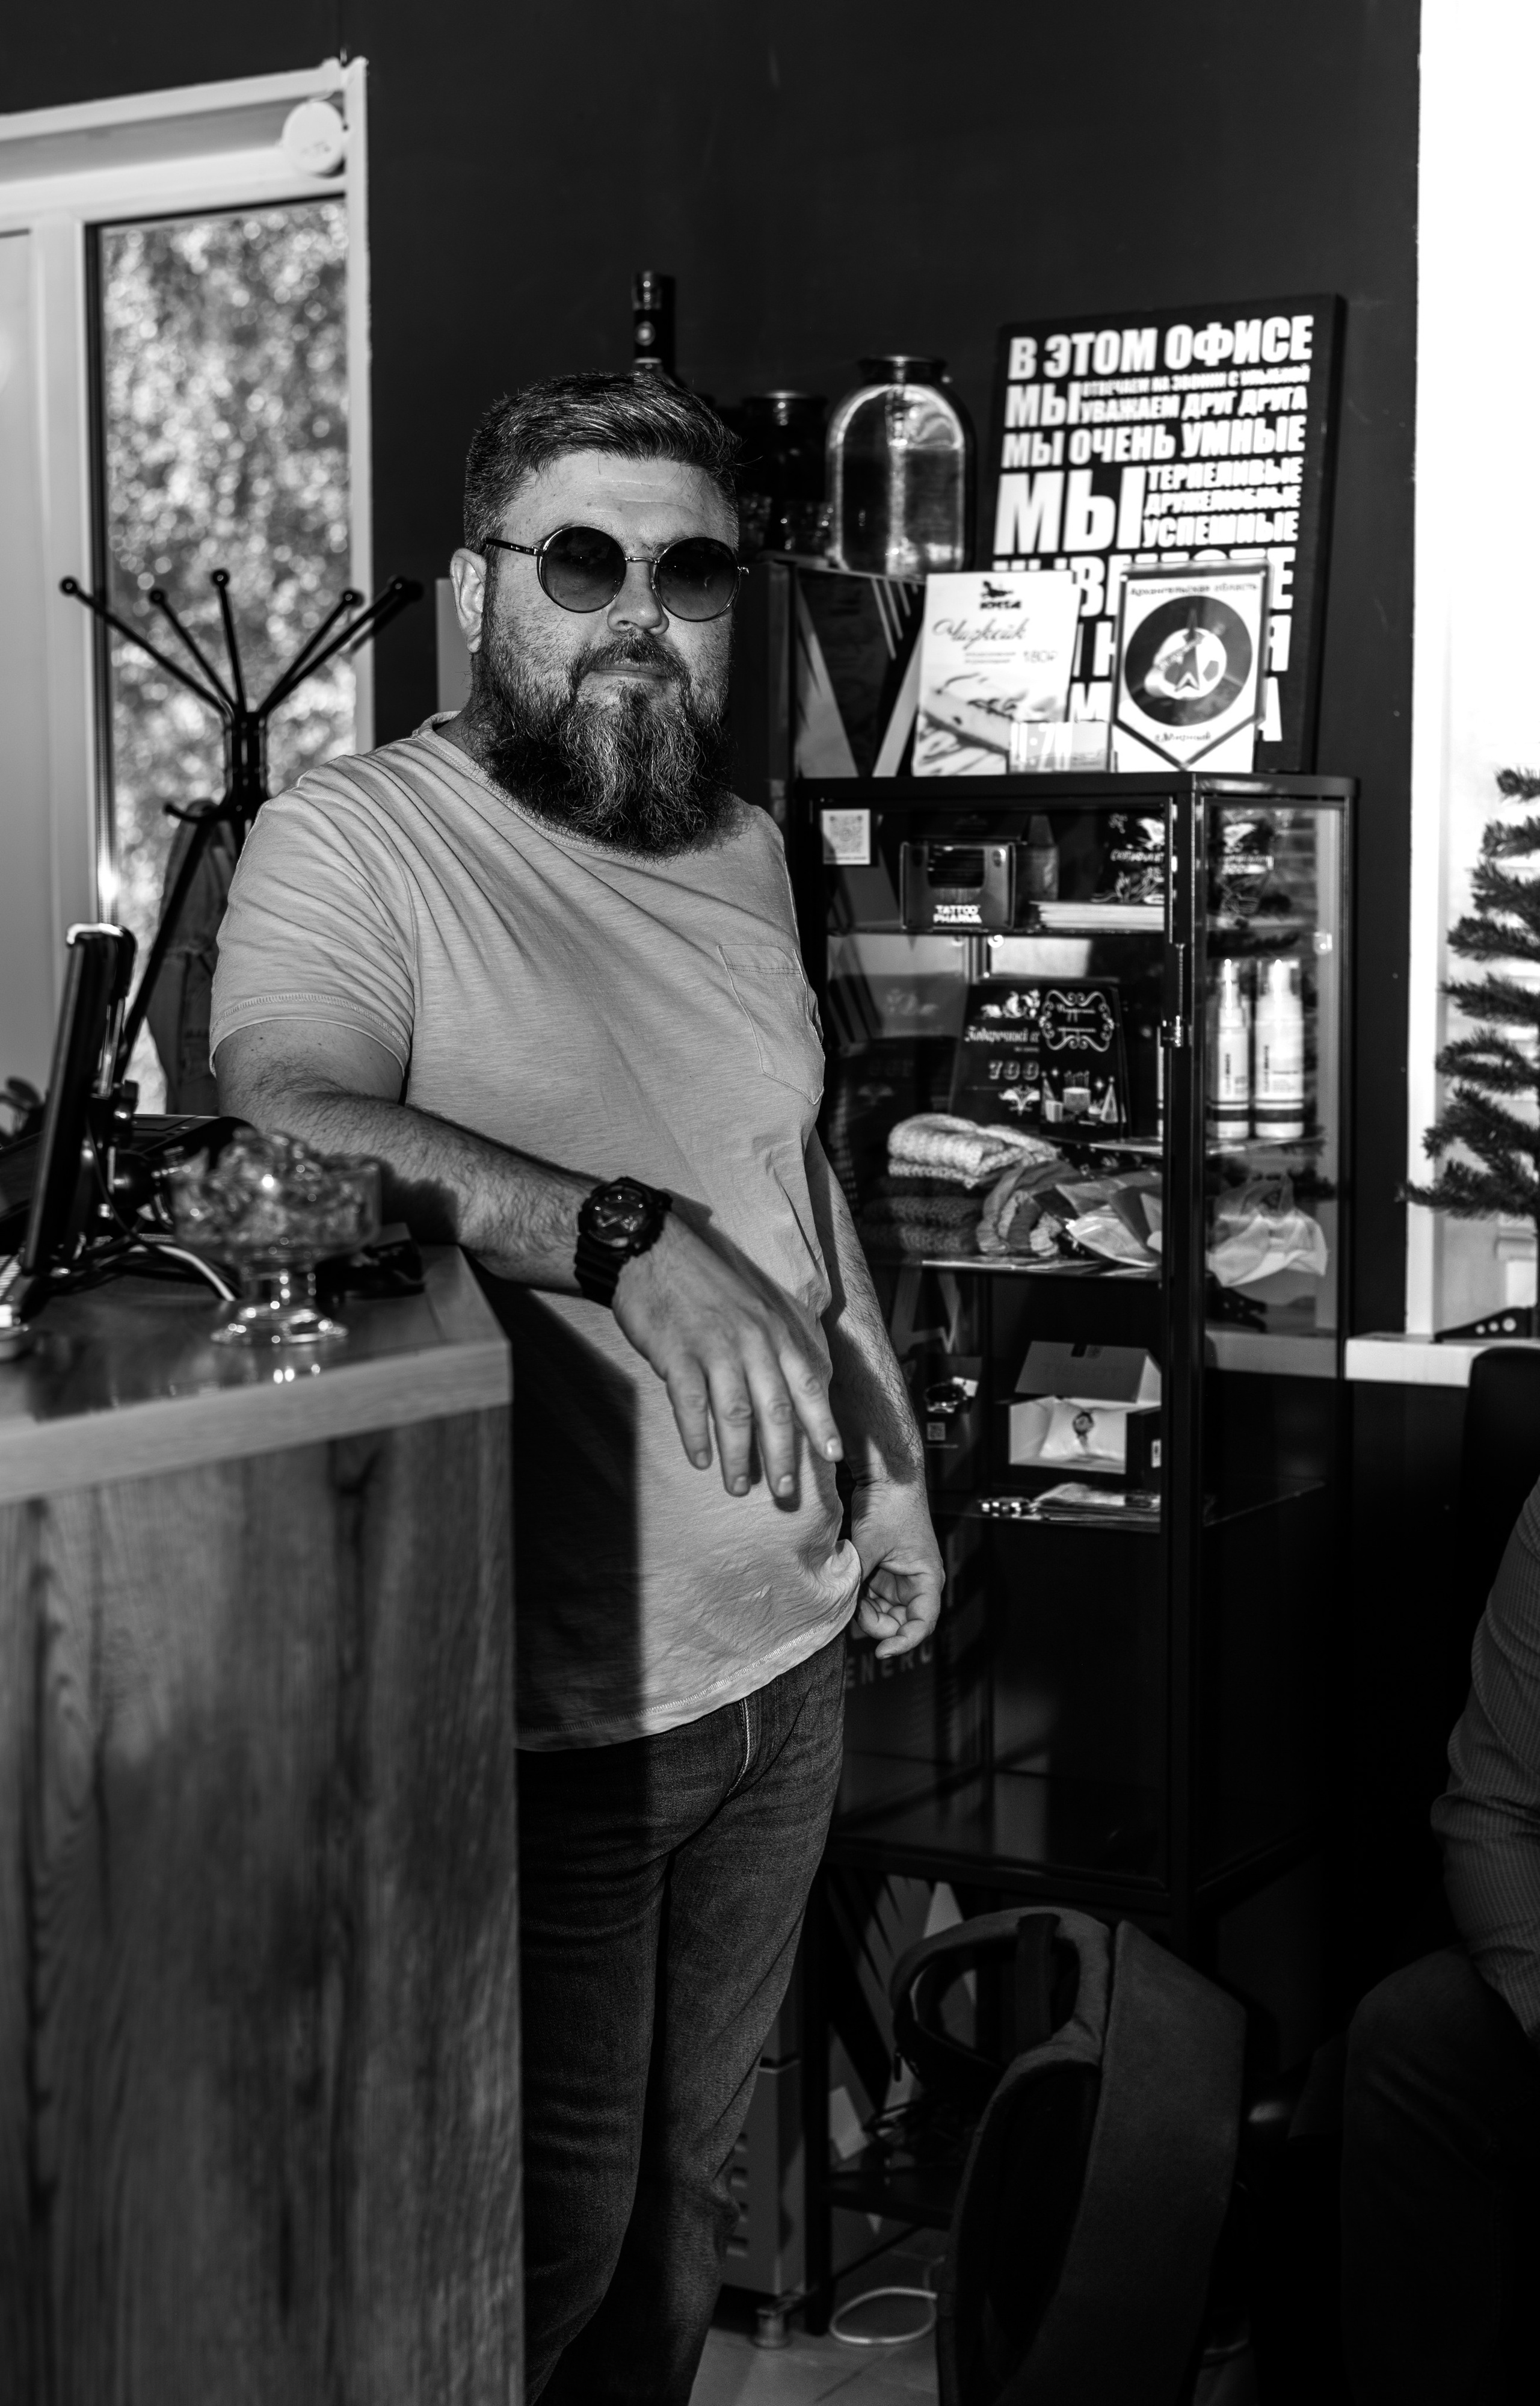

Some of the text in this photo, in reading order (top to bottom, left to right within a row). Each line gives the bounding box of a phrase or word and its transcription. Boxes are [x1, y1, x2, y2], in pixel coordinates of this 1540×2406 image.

[1008, 315, 1314, 380] В ЭТОМ ОФИСЕ
[1151, 375, 1170, 392] НА
[1228, 371, 1239, 387] С
[1005, 381, 1082, 428] МЫ
[1080, 386, 1308, 424] УВАЖАЕМ ДРУГ ДРУГА
[1001, 415, 1307, 468] МЫ ОЧЕНЬ УМНЫЕ
[1147, 457, 1304, 491] ТЕРПЕЛИВЫЕ
[993, 466, 1146, 555] МЫ
[1142, 511, 1299, 548] УСПЕШНЫЕ
[935, 904, 979, 916] TATTOO
